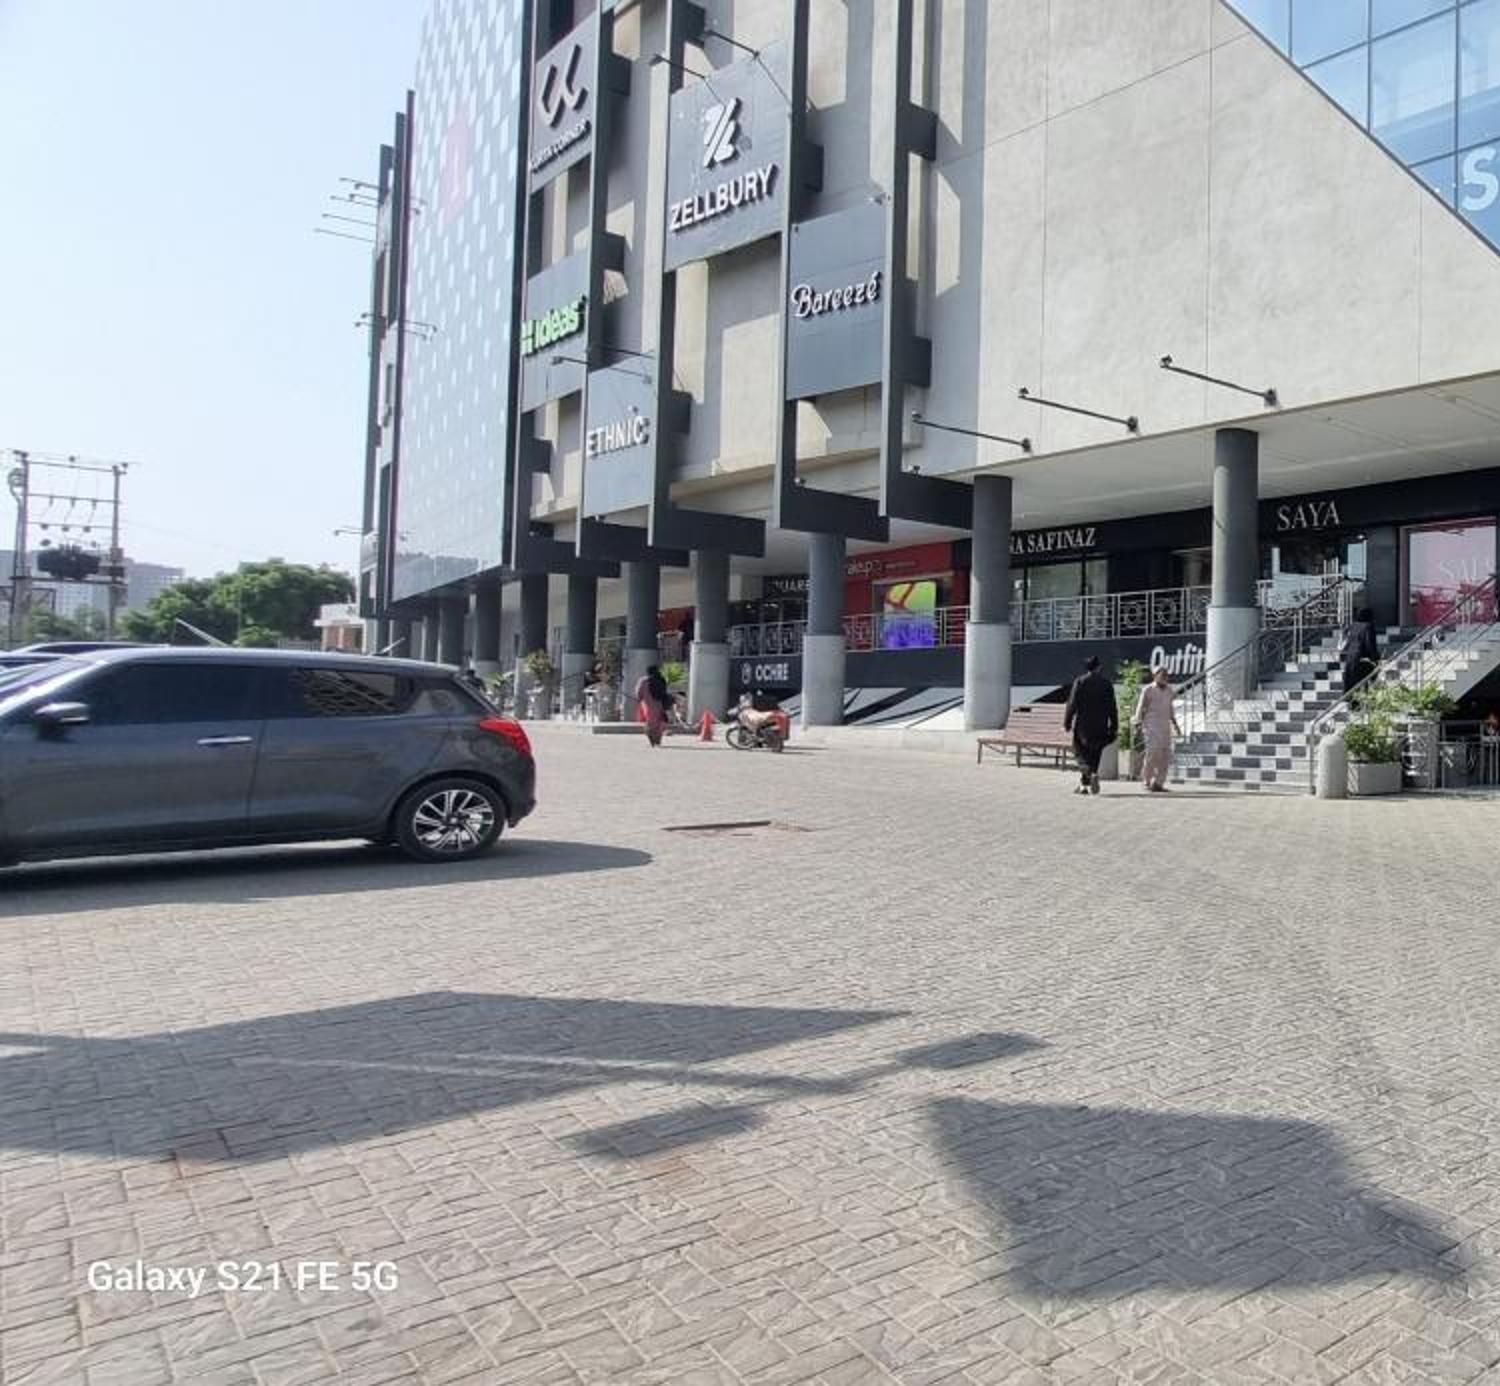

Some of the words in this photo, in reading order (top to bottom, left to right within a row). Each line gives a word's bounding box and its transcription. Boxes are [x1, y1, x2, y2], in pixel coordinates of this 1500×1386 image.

[669, 163, 774, 231] ZELLBURY
[791, 272, 879, 318] Bareezé
[586, 415, 644, 457] ETHNIC
[1277, 501, 1341, 531] SAYA
[1027, 527, 1096, 553] SAFINAZ
[755, 662, 789, 681] OCHRE
